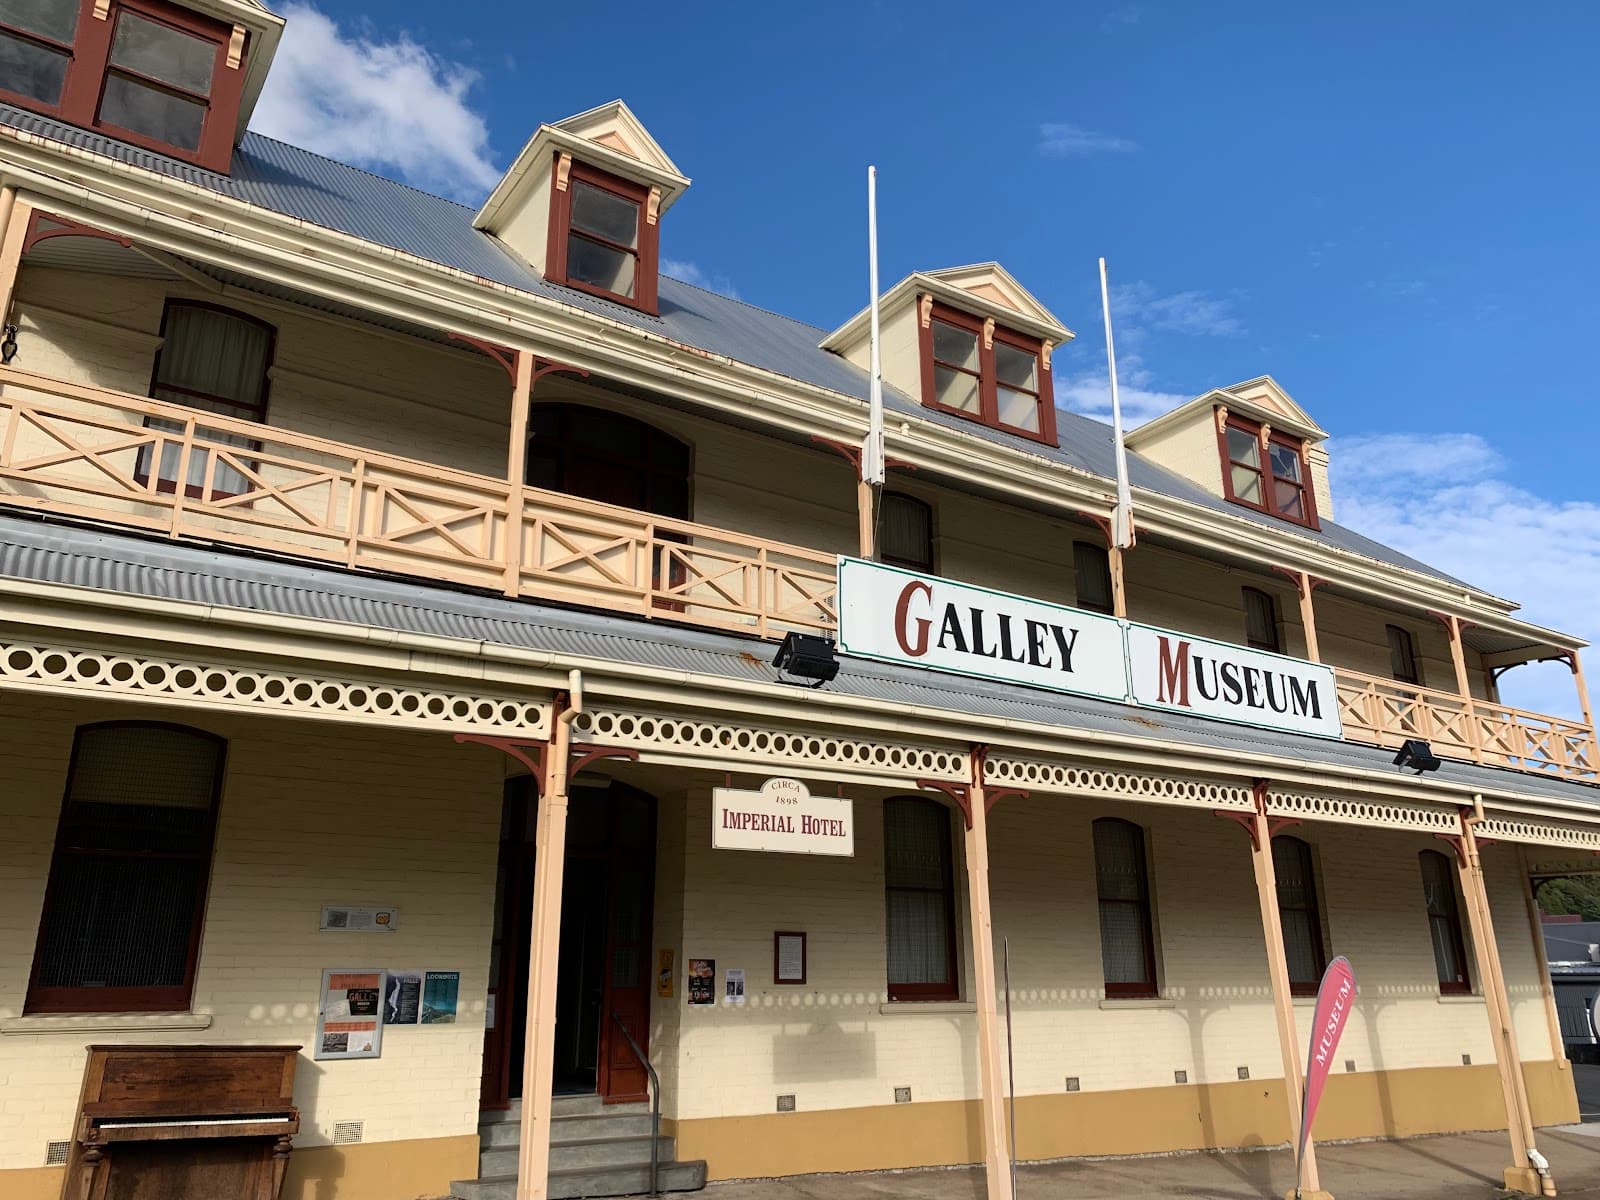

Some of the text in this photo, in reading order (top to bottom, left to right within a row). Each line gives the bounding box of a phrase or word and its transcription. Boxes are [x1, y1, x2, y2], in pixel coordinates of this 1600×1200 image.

[895, 580, 1323, 720] GALLEY MUSEUM
[771, 781, 800, 793] CIRCA
[776, 796, 799, 805] 1898
[722, 808, 847, 837] IMPERIAL HOTEL
[1316, 977, 1352, 1067] MUSEUM
